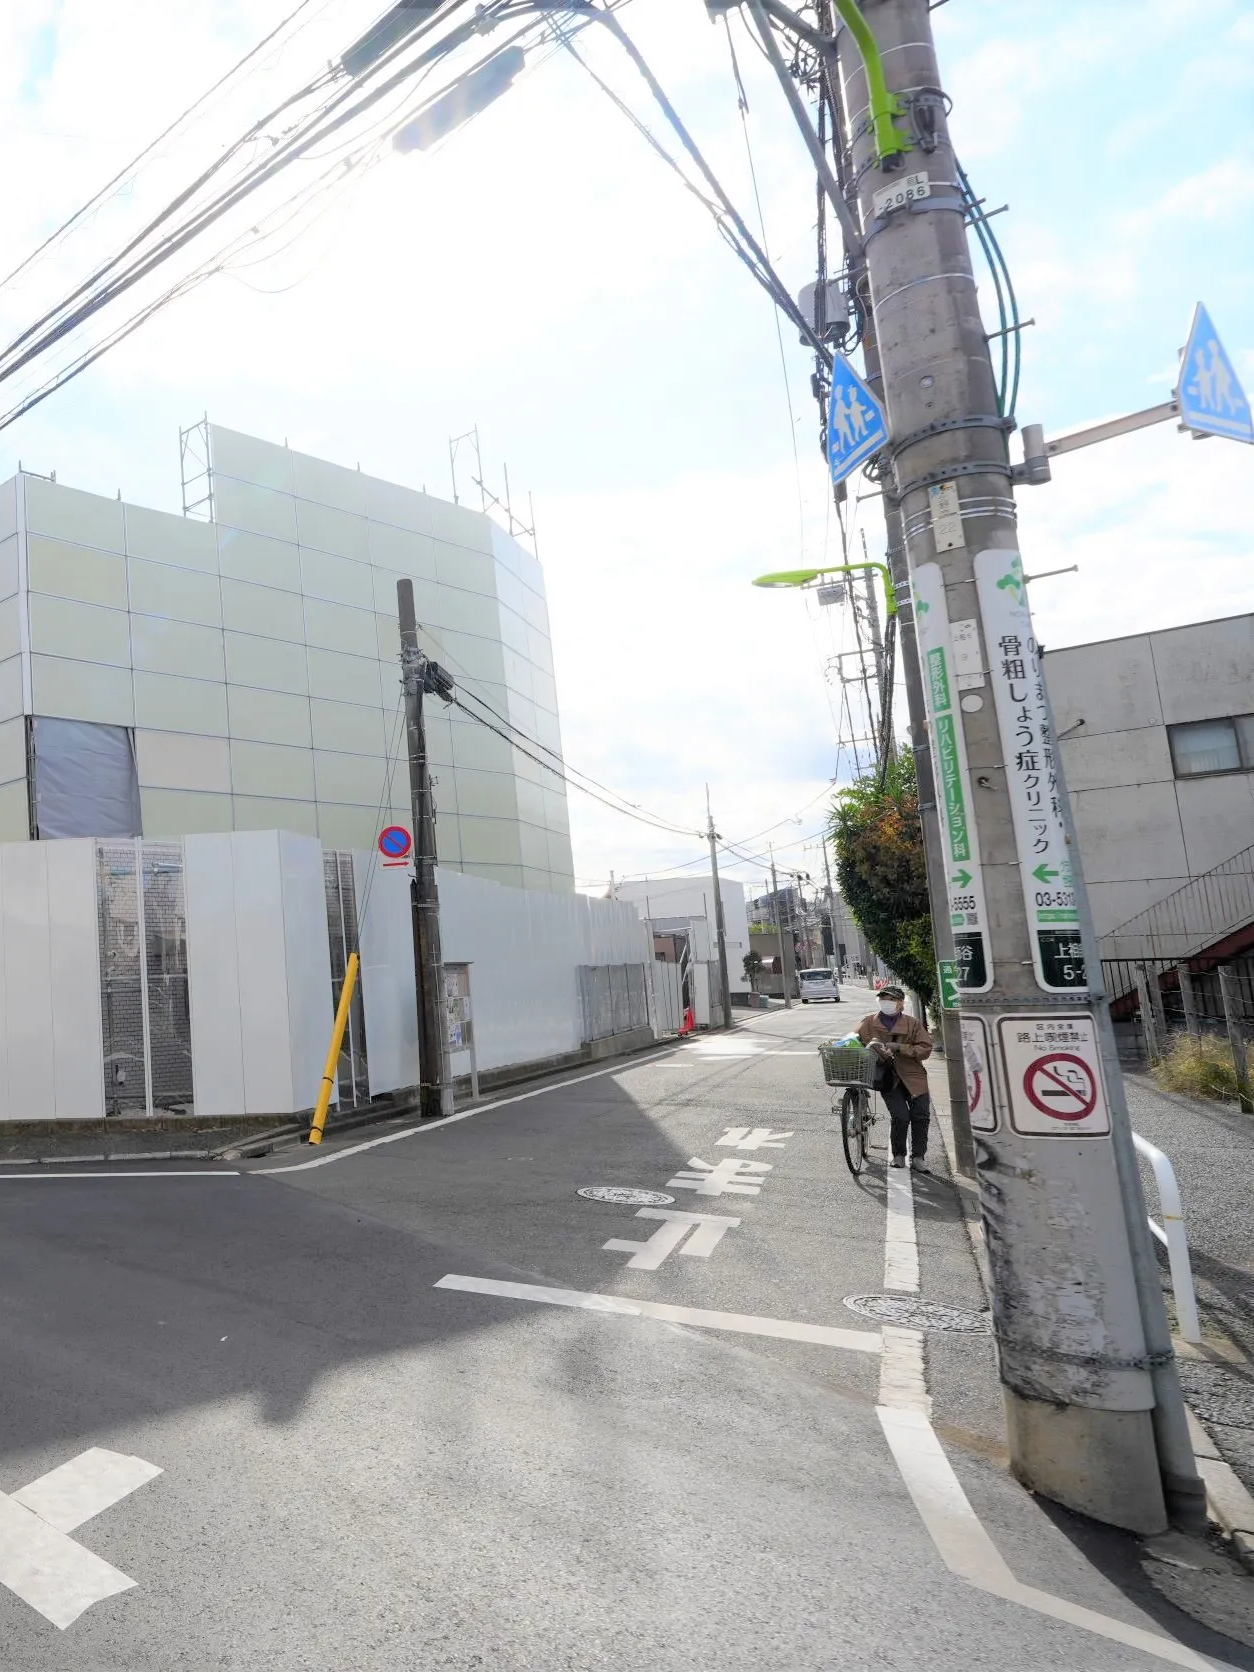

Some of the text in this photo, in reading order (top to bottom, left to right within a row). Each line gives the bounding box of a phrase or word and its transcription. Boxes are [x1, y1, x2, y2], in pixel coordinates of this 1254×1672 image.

[929, 652, 947, 706] 整形外科
[998, 635, 1049, 854] 骨粗しょう症クリニック
[938, 719, 966, 858] リハビリテーション科
[1016, 1032, 1089, 1043] 路上喫煙禁止
[1048, 1044, 1081, 1053] Smoking
